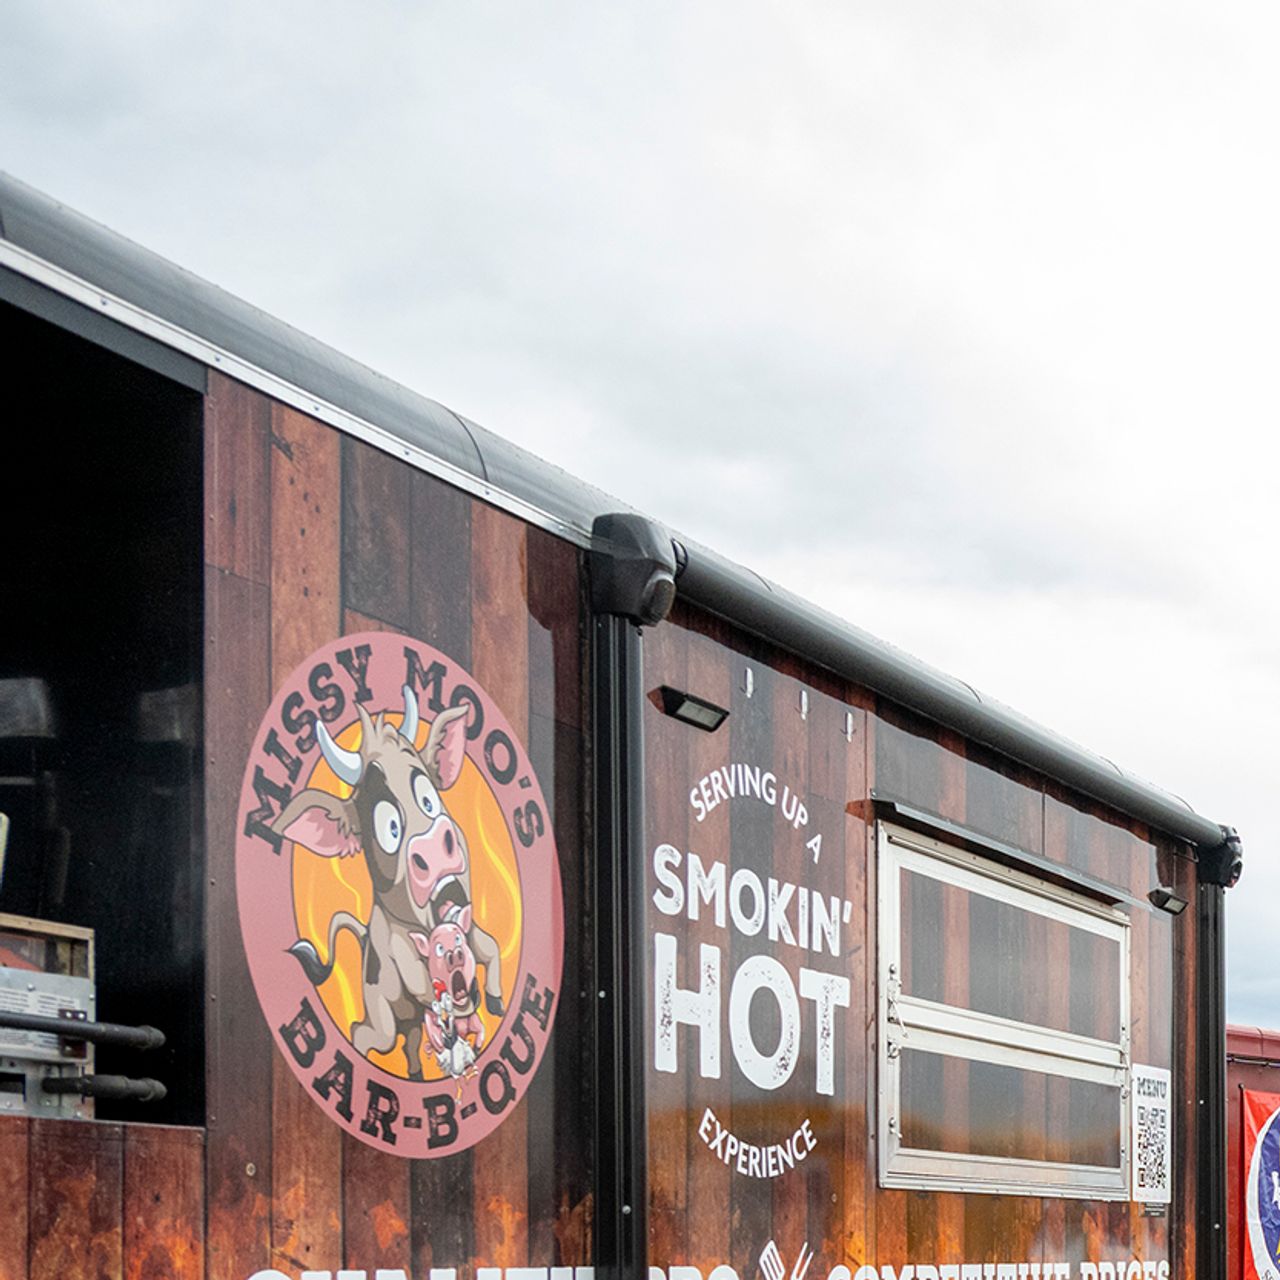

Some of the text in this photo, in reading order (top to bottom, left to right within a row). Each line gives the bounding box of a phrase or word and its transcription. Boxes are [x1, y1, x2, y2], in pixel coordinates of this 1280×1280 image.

[243, 643, 545, 856] MISSY MOO'S
[689, 763, 823, 864] SERVING UP A
[652, 843, 852, 958] SMOKIN'
[278, 972, 555, 1151] BAR-B-QUE
[653, 932, 850, 1097] HOT
[698, 1107, 818, 1179] EXPERIENCE
[1137, 1077, 1167, 1099] MENU
